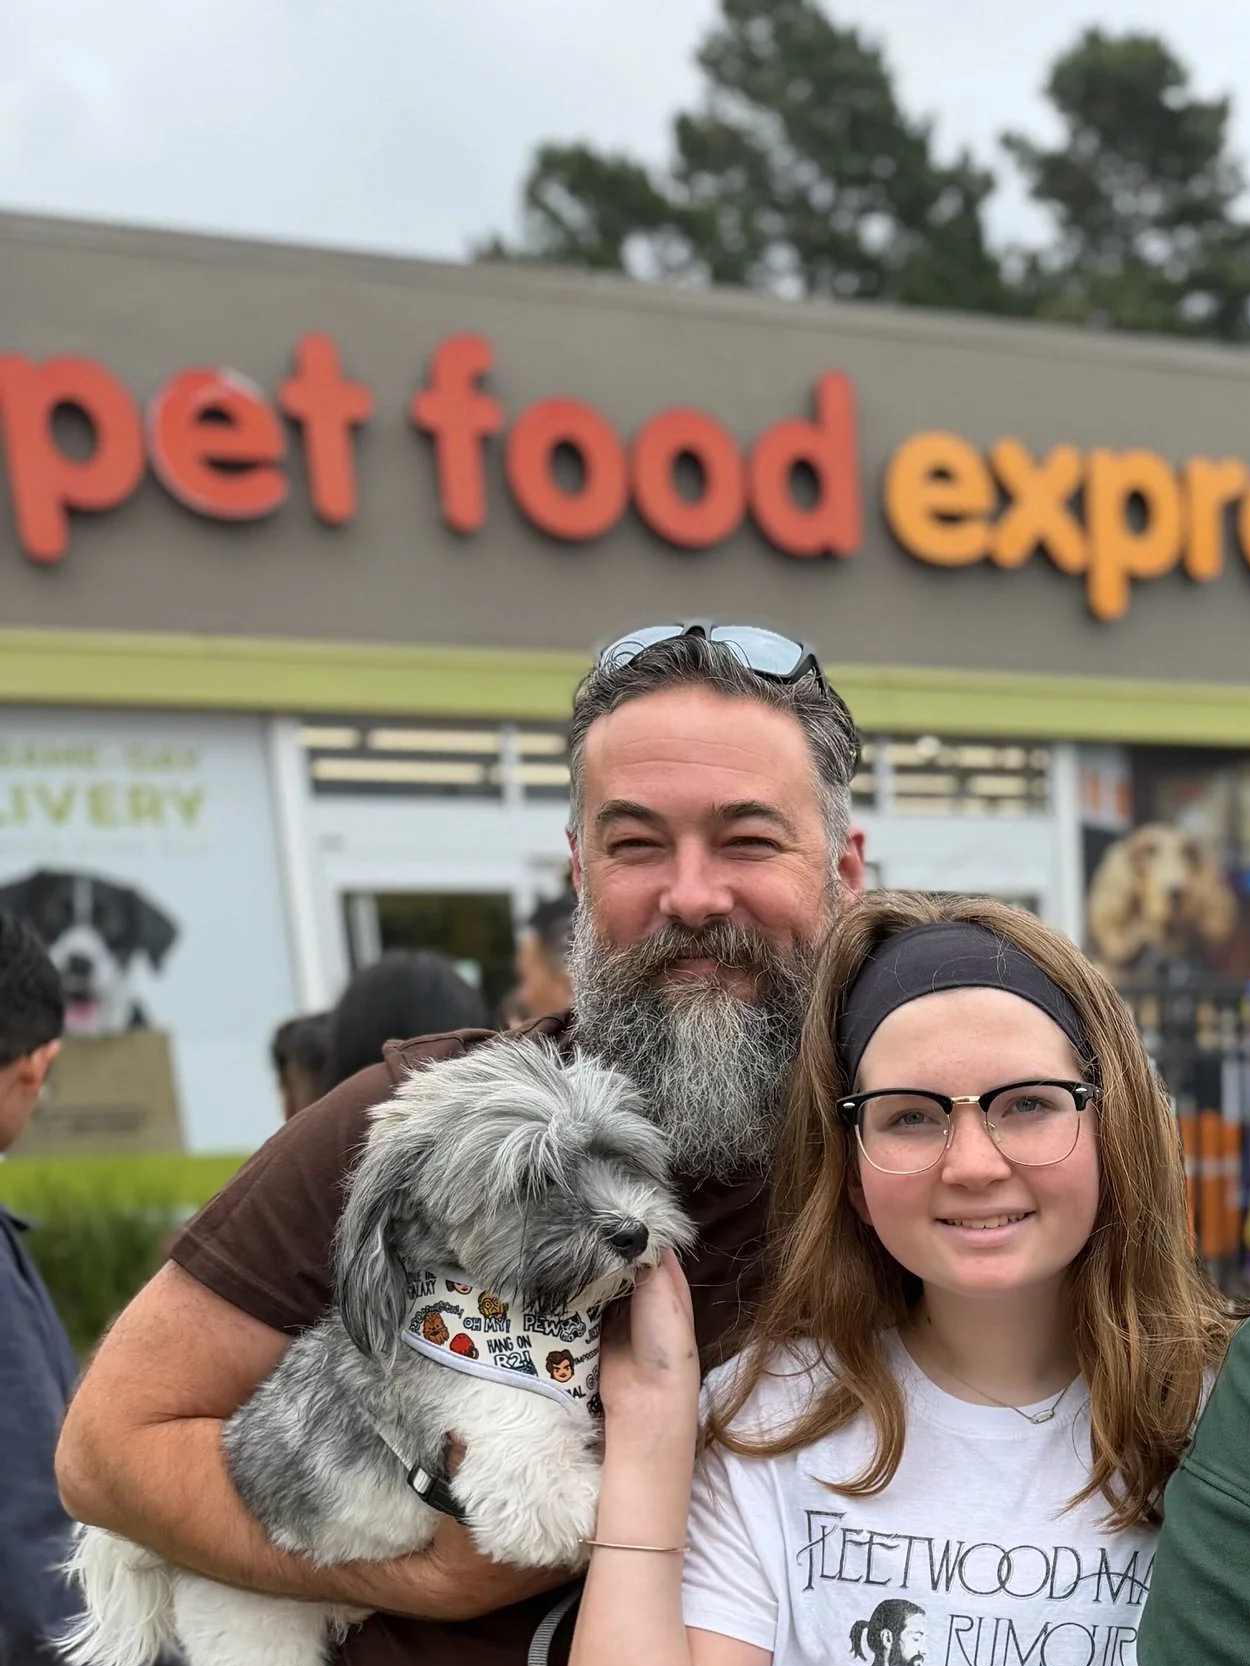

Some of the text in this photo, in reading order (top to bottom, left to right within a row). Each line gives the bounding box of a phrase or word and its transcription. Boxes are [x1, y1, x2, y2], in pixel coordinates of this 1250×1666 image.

[0, 332, 371, 562] pet
[412, 332, 861, 557] food
[0, 782, 204, 826] IVERY
[463, 1317, 482, 1331] OH
[484, 1317, 511, 1333] MY!
[523, 1313, 560, 1337] PEW
[487, 1334, 532, 1354] HANG ON
[796, 1509, 1084, 1600] FLEETWOOD
